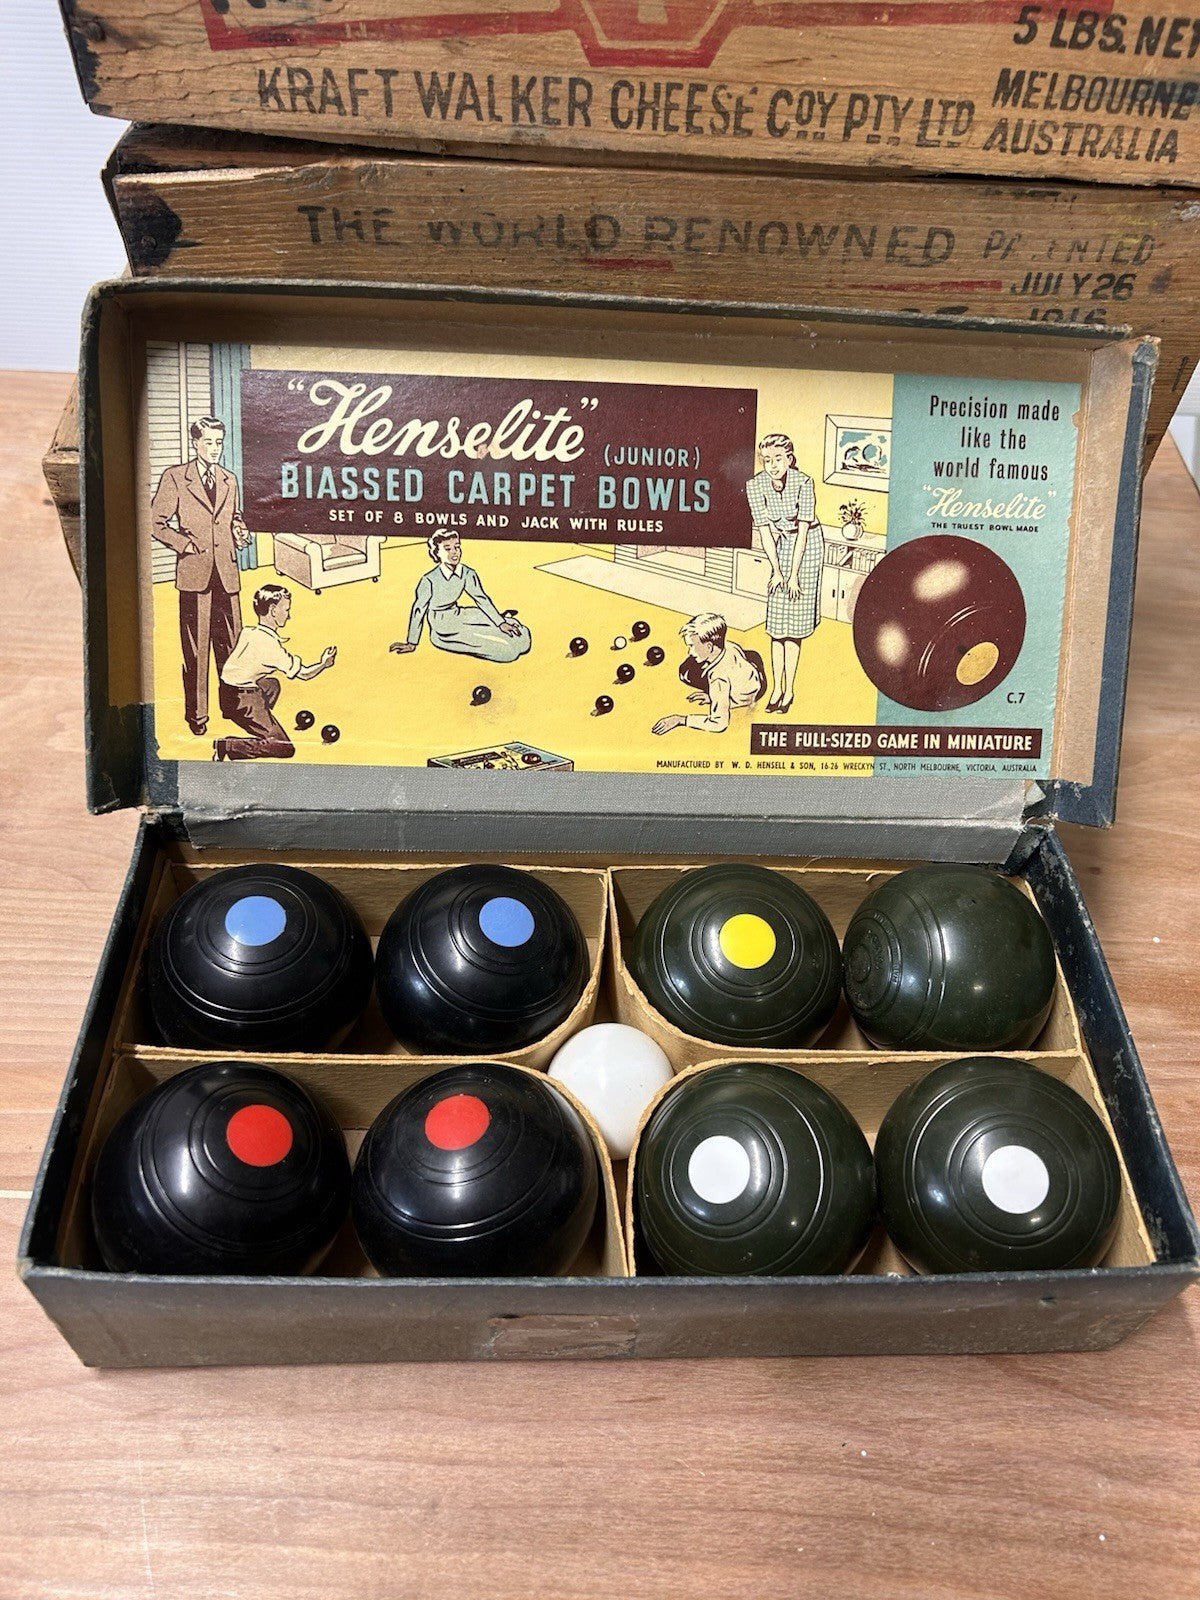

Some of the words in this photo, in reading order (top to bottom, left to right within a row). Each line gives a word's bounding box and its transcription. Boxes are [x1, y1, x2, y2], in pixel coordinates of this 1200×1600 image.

[1013, 5, 1041, 45] 5
[991, 67, 1200, 121] MELBOURNE
[257, 67, 399, 117] KRAFT
[414, 70, 594, 127] WALKER
[610, 79, 759, 138] CHEESE
[843, 92, 914, 146] PTY
[916, 98, 976, 148] LTD
[983, 117, 1179, 163] AUSTRALIA
[298, 204, 399, 246] THE
[427, 212, 622, 251] WORLD
[645, 215, 955, 267] RENOWNED
[1090, 272, 1138, 301] 26
[929, 395, 1008, 419] Precision
[1017, 399, 1060, 421] made
[960, 426, 991, 448] like
[1000, 428, 1027, 450] the
[603, 443, 701, 470] (JUNIOR)
[933, 457, 980, 478] world
[990, 458, 1049, 481] famous
[281, 463, 424, 503] BIASSED
[448, 470, 577, 508] CARPET
[598, 475, 711, 514] BOWLS
[328, 509, 355, 523] SET
[364, 511, 383, 524] OF
[393, 512, 404, 524] 8
[415, 513, 468, 526] BOWLS
[476, 516, 510, 528] AND
[521, 517, 562, 531] JACK
[569, 519, 608, 532] WITH
[616, 520, 664, 534] RULES
[931, 521, 948, 529] THE
[951, 522, 985, 531] TRUEST
[989, 524, 1014, 532] BOWL
[1016, 525, 1039, 533] MADE
[1006, 692, 1025, 704] C.7
[759, 732, 787, 748] THE
[795, 731, 872, 749] FULL-SIZED
[877, 733, 918, 750] GAME
[923, 733, 940, 750] IN
[947, 734, 1033, 751] MINIATURE
[656, 760, 711, 769] MANUFACTURED
[714, 761, 724, 769] BY
[731, 761, 741, 770] W.
[745, 761, 752, 770] D.
[756, 762, 786, 770] HENSELL
[790, 762, 795, 770] &
[799, 762, 816, 771] SON,
[843, 763, 875, 771] WRECKYN
[893, 763, 917, 772] NORTH
[920, 764, 961, 773] MELBOURNE,
